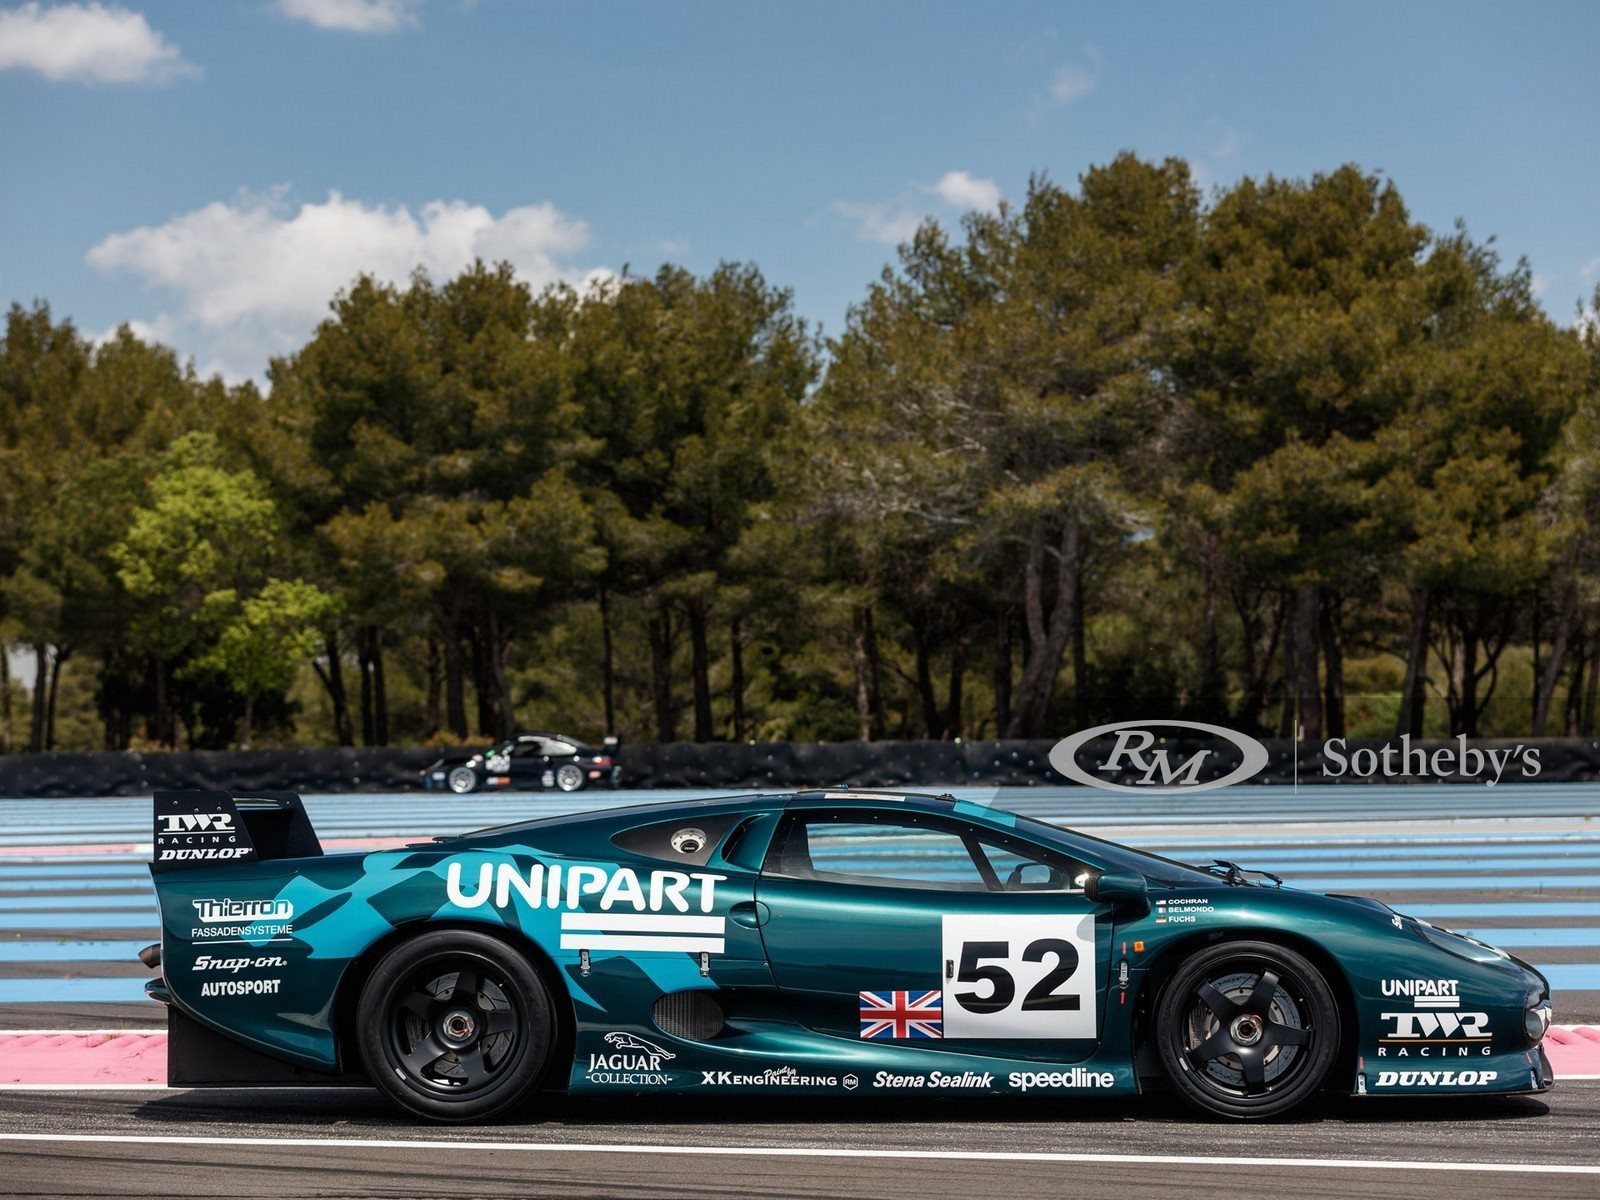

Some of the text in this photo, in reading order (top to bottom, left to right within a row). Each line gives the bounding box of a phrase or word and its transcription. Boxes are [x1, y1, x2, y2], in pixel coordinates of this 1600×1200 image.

[157, 813, 236, 832] TWR
[158, 835, 236, 844] RACING
[159, 848, 251, 860] DUNLOP
[446, 862, 728, 913] UNIPART
[192, 898, 293, 923] Thierron
[191, 924, 293, 938] FASSADENSYSTEME
[192, 955, 284, 973] Snap-on
[954, 938, 1081, 1015] 52
[201, 979, 281, 997] AUTOSPORT
[1381, 979, 1459, 996] UNIPART
[1380, 1012, 1493, 1038] TWR
[1377, 1046, 1491, 1057] RACING
[587, 1053, 661, 1073] JAGUAR
[872, 1070, 995, 1088] Stena Sealink
[1008, 1067, 1115, 1092] speedline
[1375, 1071, 1498, 1087] DUNLOP
